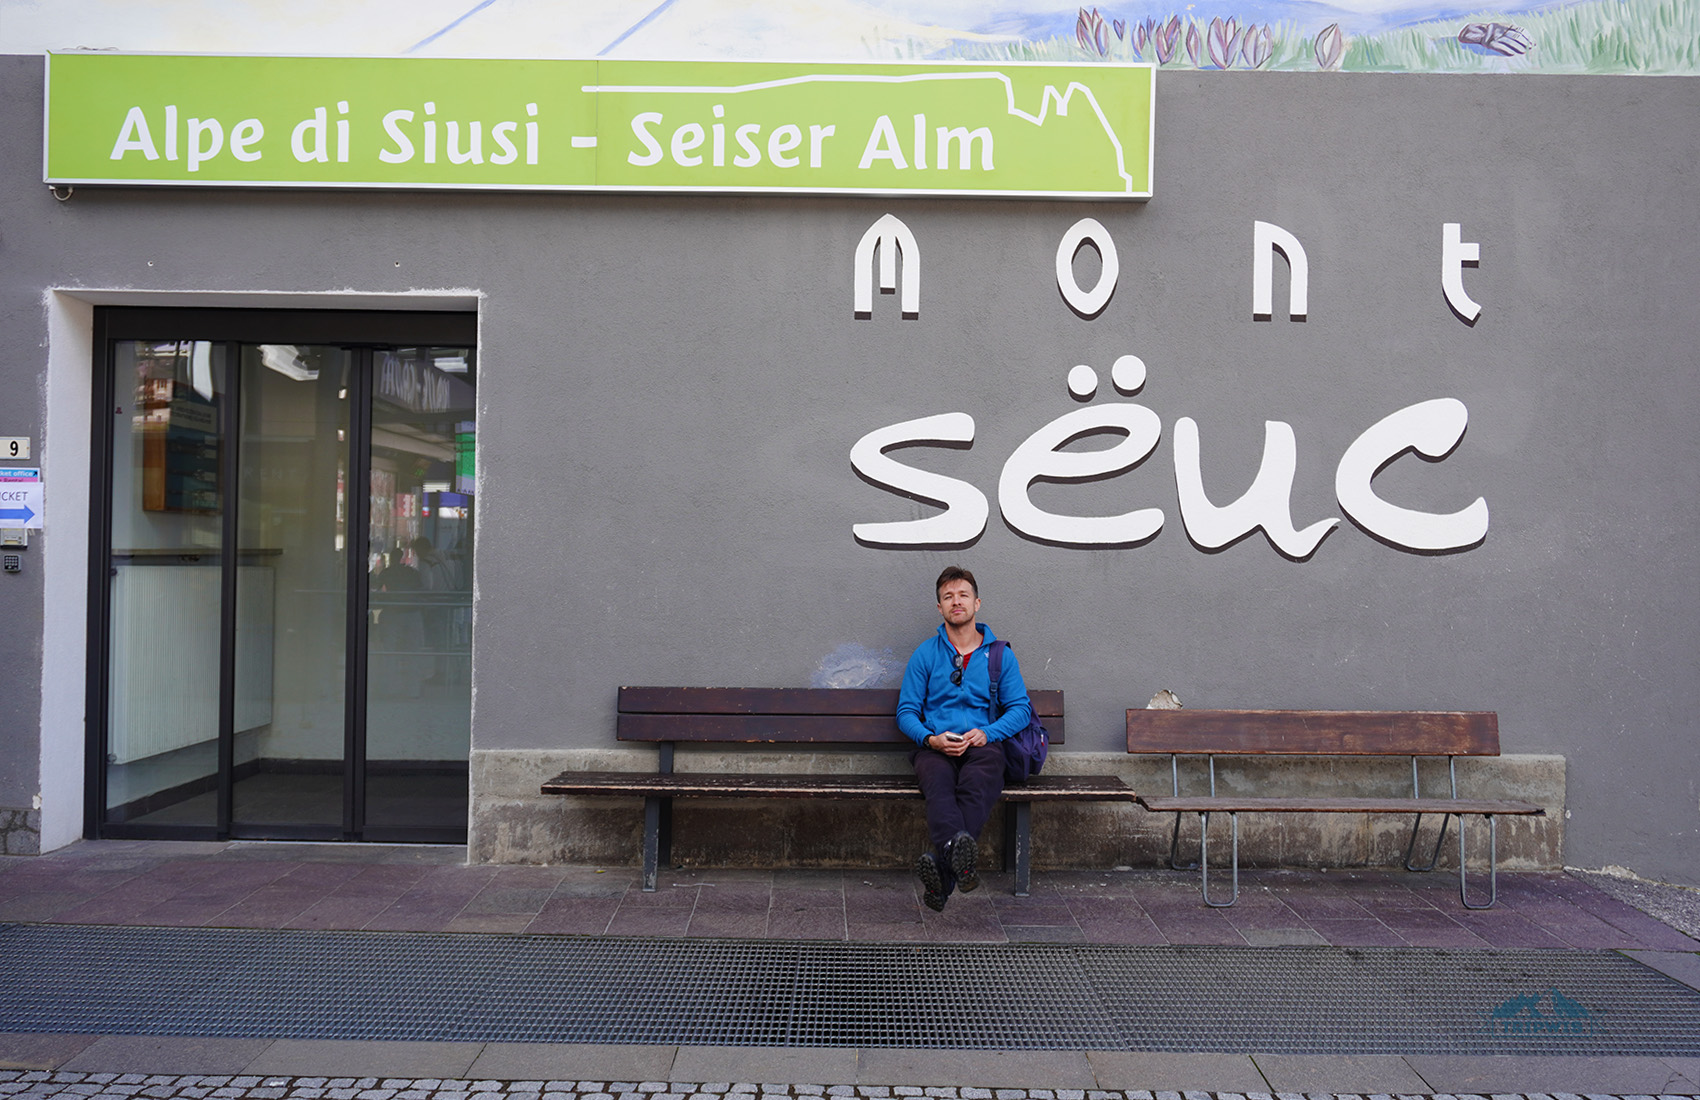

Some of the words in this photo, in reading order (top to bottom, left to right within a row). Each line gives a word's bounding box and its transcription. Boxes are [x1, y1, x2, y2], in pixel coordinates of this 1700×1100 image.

[110, 105, 264, 172] Alpe
[290, 101, 350, 163] di
[378, 102, 539, 165] Siusi
[627, 104, 837, 169] Seiser
[857, 113, 996, 171] Alm
[10, 440, 19, 457] 9
[849, 354, 1490, 560] sëuc
